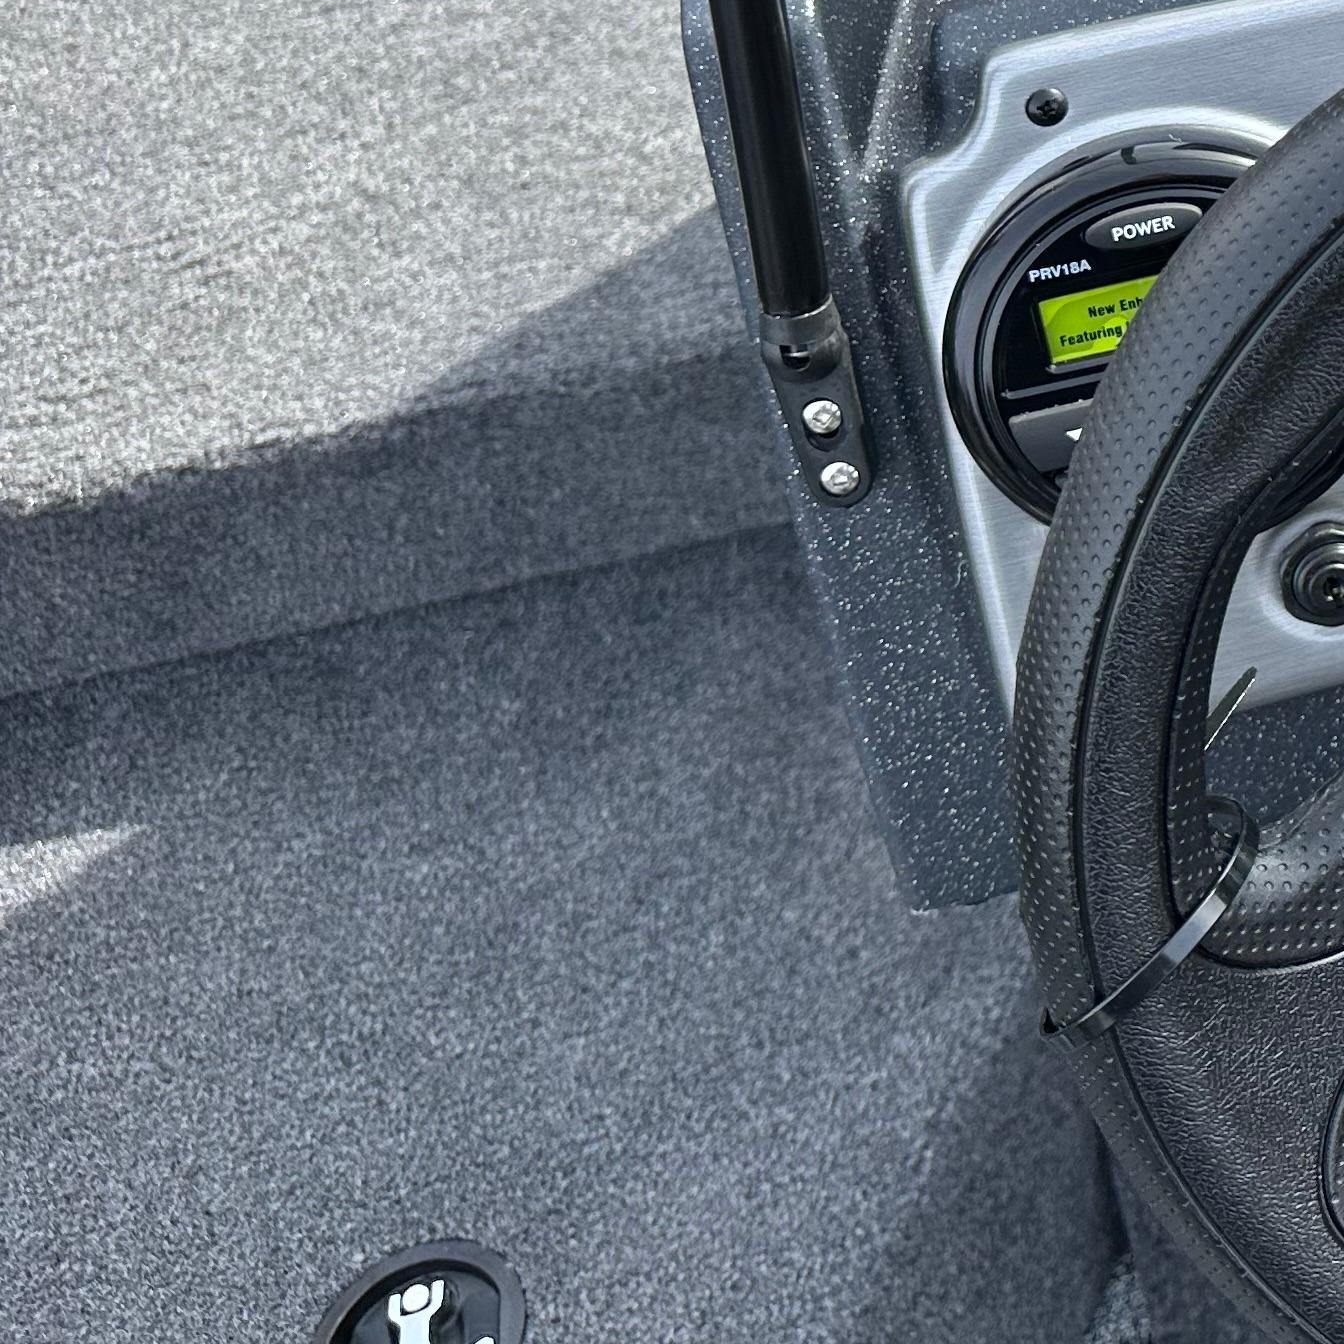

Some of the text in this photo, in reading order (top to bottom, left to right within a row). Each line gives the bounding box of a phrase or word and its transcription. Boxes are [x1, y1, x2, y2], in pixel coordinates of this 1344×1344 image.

[1111, 215, 1175, 242] POWER
[1029, 260, 1091, 283] PRV18A
[1088, 302, 1115, 318] New
[1060, 324, 1122, 347] Featuring
